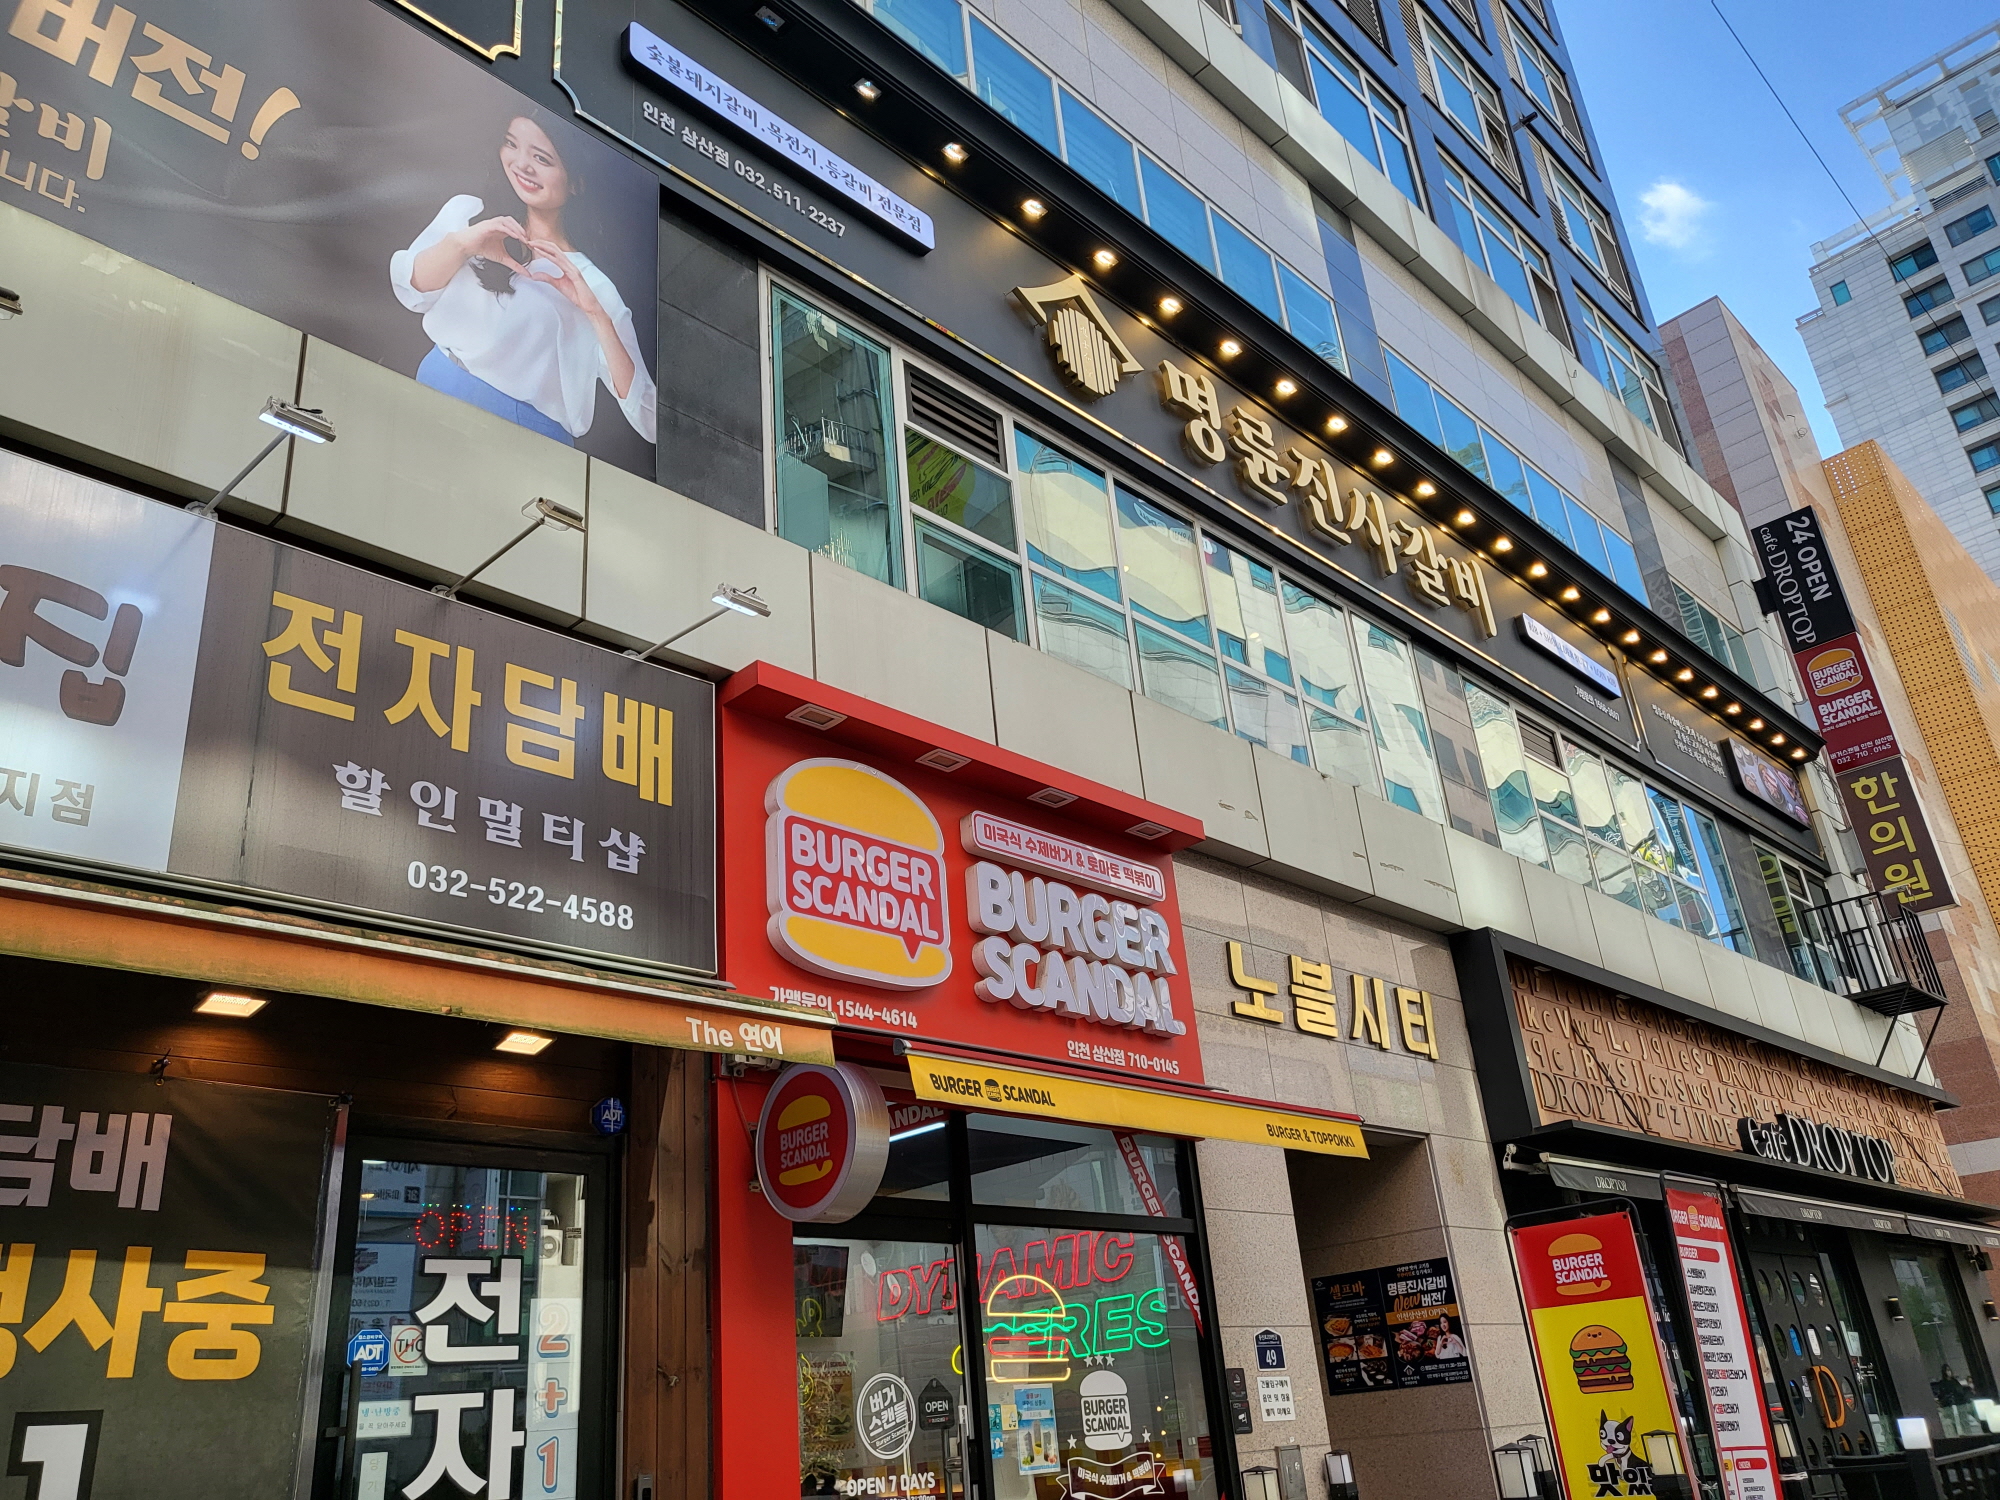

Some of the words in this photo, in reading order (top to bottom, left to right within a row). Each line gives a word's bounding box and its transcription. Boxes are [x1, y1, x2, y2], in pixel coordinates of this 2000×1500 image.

[8, 0, 301, 161] 버전!
[642, 100, 676, 136] 인천
[681, 124, 729, 168] 삼산점
[734, 159, 847, 238] 032.511.2237
[877, 192, 922, 234] 전문점
[1160, 358, 1498, 638] 명륜진사갈비
[1785, 516, 1815, 544] 24
[1797, 546, 1833, 602] OPEN
[1767, 549, 1817, 644] DROPTOP
[1812, 659, 1855, 681] BURGER
[1816, 668, 1858, 689] SCANDAL
[262, 590, 674, 807] 전자담배
[1818, 689, 1874, 716] BURGER
[1822, 700, 1878, 726] SCANDAL
[1860, 740, 1874, 750] 인천
[1850, 771, 1934, 904] 한의원
[791, 823, 935, 900] BURGER
[983, 821, 1022, 849] 미국식
[1024, 834, 1074, 867] 수제버거
[1076, 850, 1085, 868] &
[1086, 853, 1121, 881] 토마토
[1123, 863, 1156, 891] 떡볶이
[407, 860, 635, 931] 032-522-4588
[792, 870, 939, 939] SCANDAL
[968, 862, 1179, 976] BURGER
[973, 936, 1187, 1036] SCANDAL
[1226, 941, 1439, 1060] 노블시티
[836, 999, 918, 1029] 1544-4614
[686, 1016, 734, 1047] The
[739, 1022, 784, 1055] 연어
[1066, 1041, 1091, 1059] 인천
[1092, 1045, 1125, 1068] 삼산점
[1127, 1051, 1180, 1074] 710-0145
[929, 1073, 983, 1098] BURGER
[1004, 1085, 1056, 1108] SCANDAL
[779, 1121, 830, 1151] BURGER
[1266, 1123, 1304, 1141] BURGER
[1303, 1130, 1311, 1142] &
[1311, 1130, 1356, 1148] TOPPOKKI
[1786, 1114, 1900, 1184] DROPTOP
[780, 1141, 831, 1169] SCANDAL
[1595, 1176, 1628, 1192] DROPTOP
[415, 1211, 529, 1250] OPEN
[1698, 1215, 1724, 1230] SCANDAL
[1551, 1252, 1604, 1272] BURGER
[1555, 1266, 1608, 1285] SCANDAL
[1330, 1281, 1365, 1300] 셀프바
[1387, 1274, 1448, 1297] 명륜진사갈비
[1393, 1291, 1421, 1313] New
[1421, 1289, 1446, 1307] 버전!
[354, 1344, 384, 1361] ADT
[1266, 1349, 1277, 1366] 49
[869, 1384, 897, 1413] 버거
[925, 1400, 949, 1413] OPEN
[1083, 1397, 1127, 1416] BURGER
[868, 1400, 908, 1437] 스캔들
[1085, 1415, 1130, 1433] SCANDAL
[847, 1476, 886, 1497] OPEN
[888, 1475, 897, 1492] 7
[900, 1471, 936, 1492] DAYS
[1077, 1466, 1098, 1485] 미국식
[1099, 1474, 1127, 1486] 수제버거
[1126, 1471, 1133, 1482] &
[1132, 1459, 1152, 1479] 떡볶이
